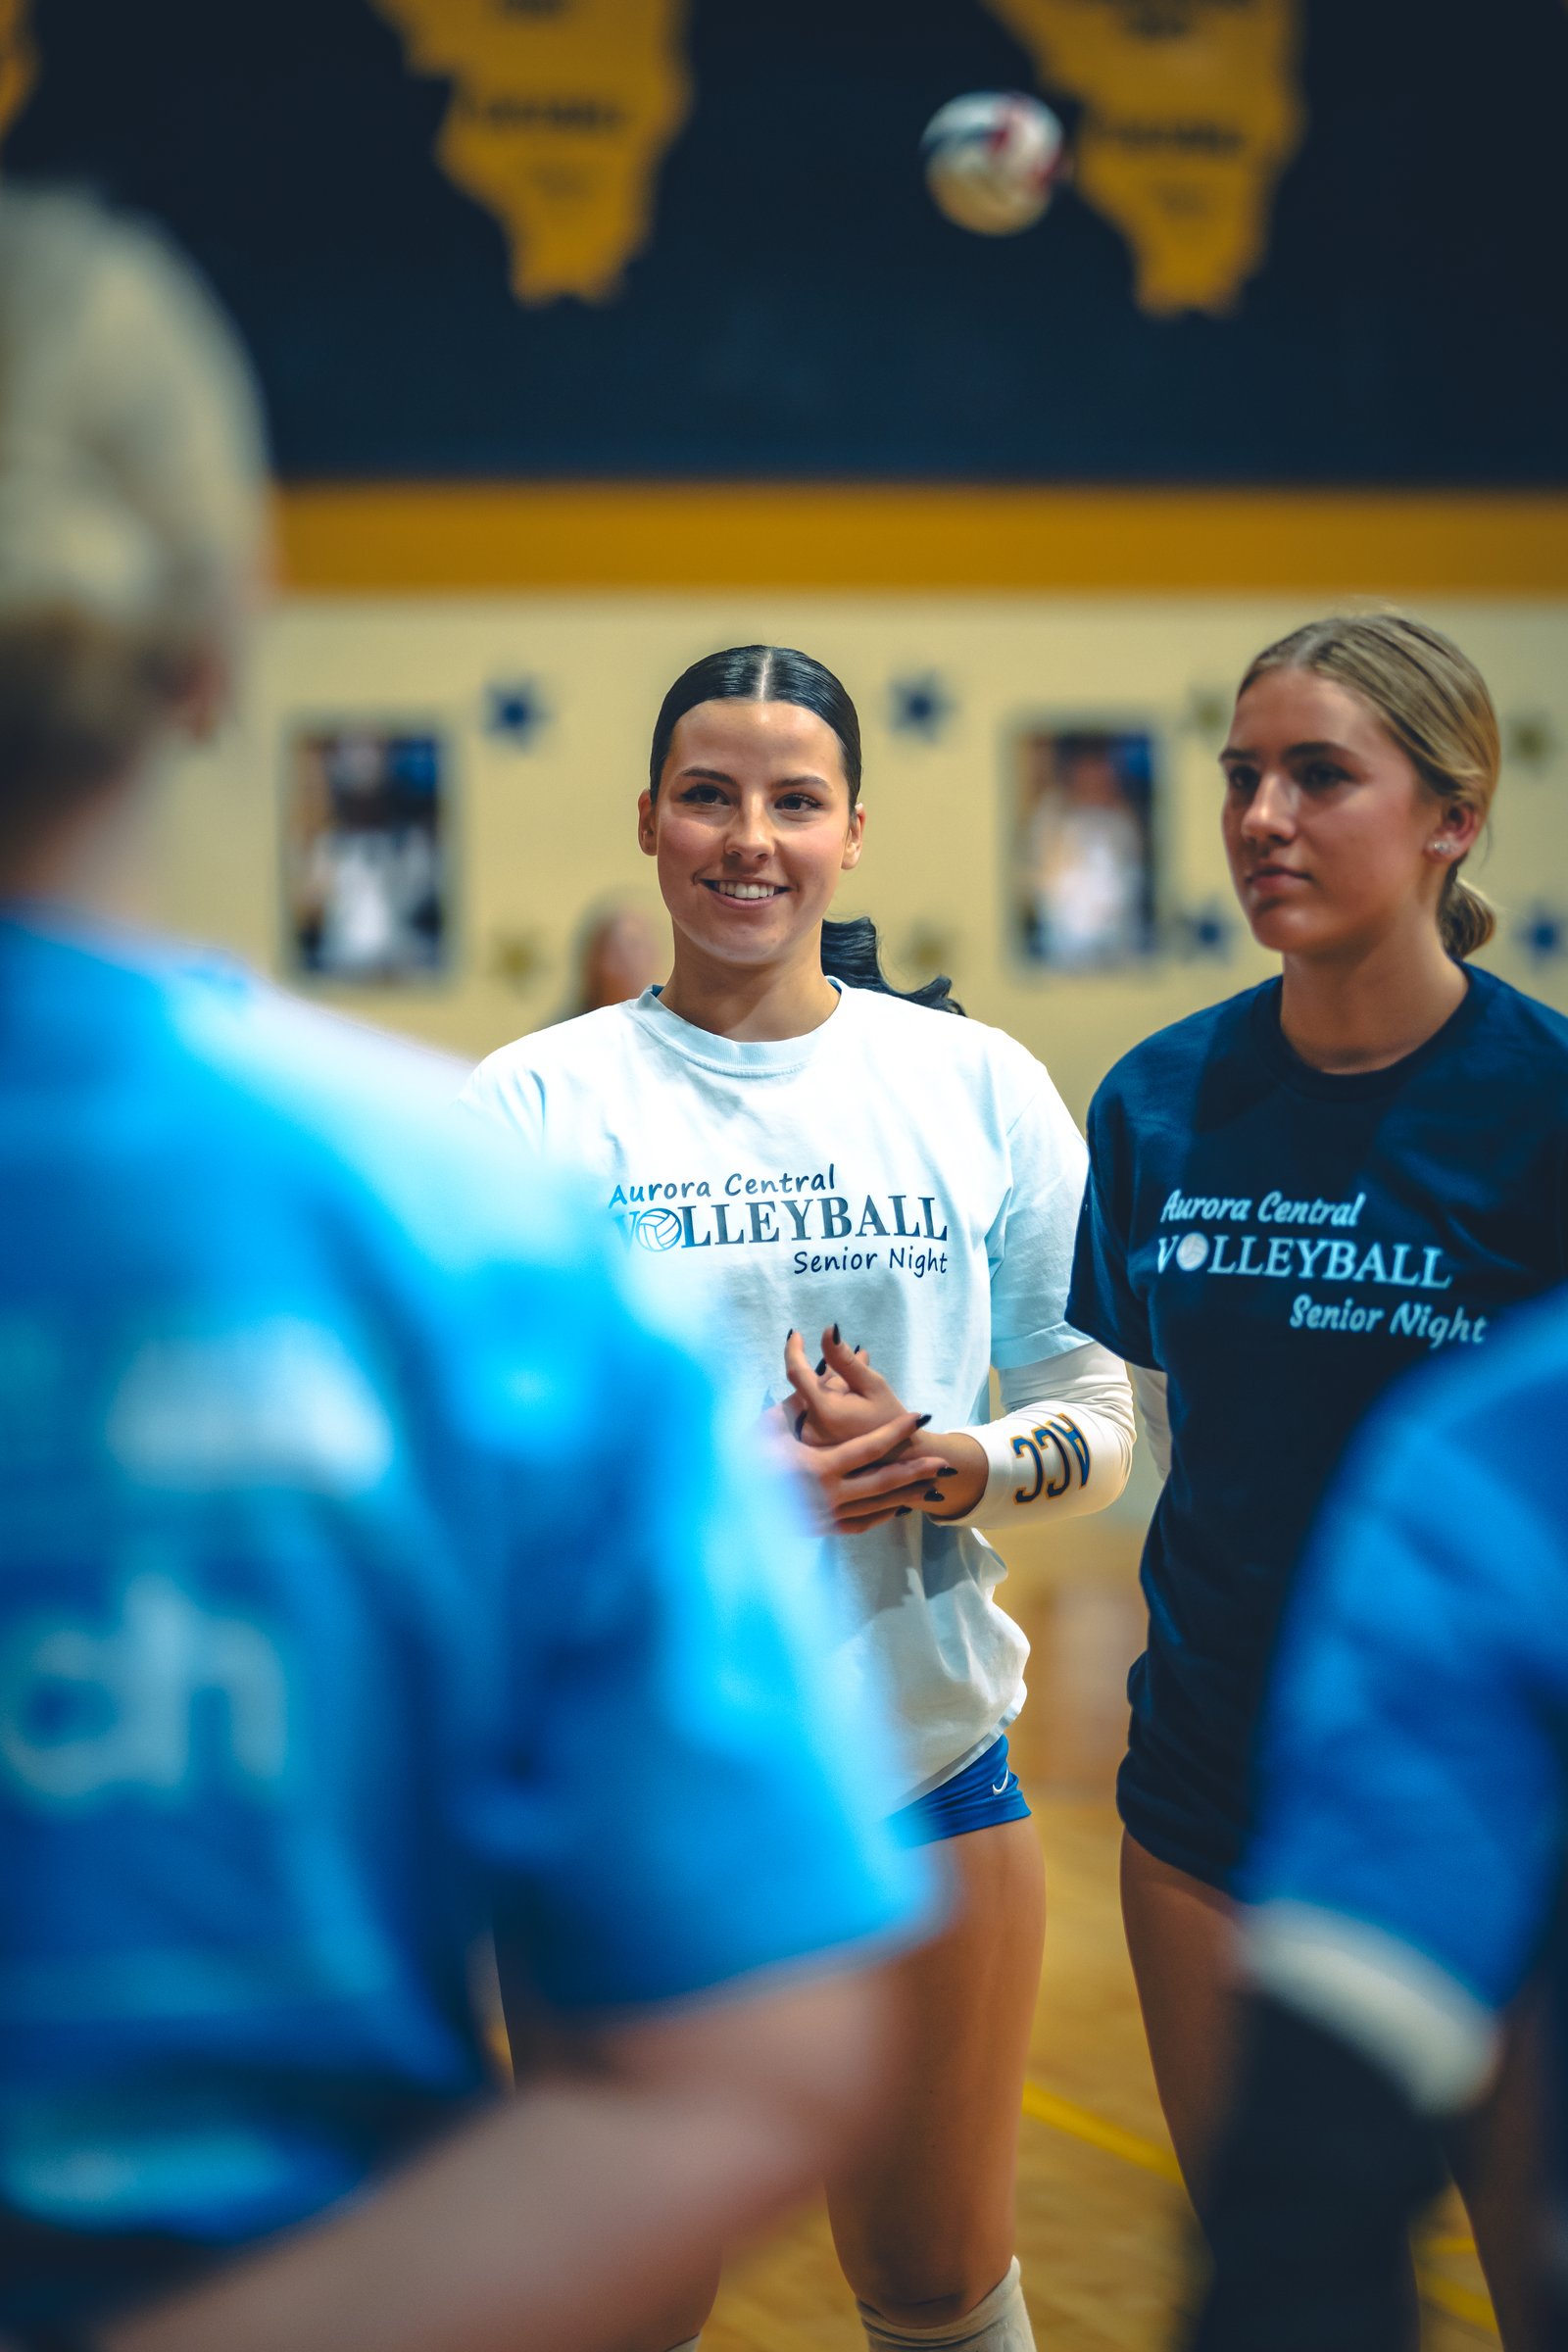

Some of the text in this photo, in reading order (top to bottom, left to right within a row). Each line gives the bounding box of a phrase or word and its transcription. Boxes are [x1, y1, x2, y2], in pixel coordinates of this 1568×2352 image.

[609, 1163, 835, 1208] Aurora Central
[1160, 1189, 1366, 1227] Aurora Central
[794, 1247, 948, 1278] Senior Night
[1156, 1231, 1452, 1289] VOLLEYBALL
[1289, 1293, 1488, 1349] Senior Night
